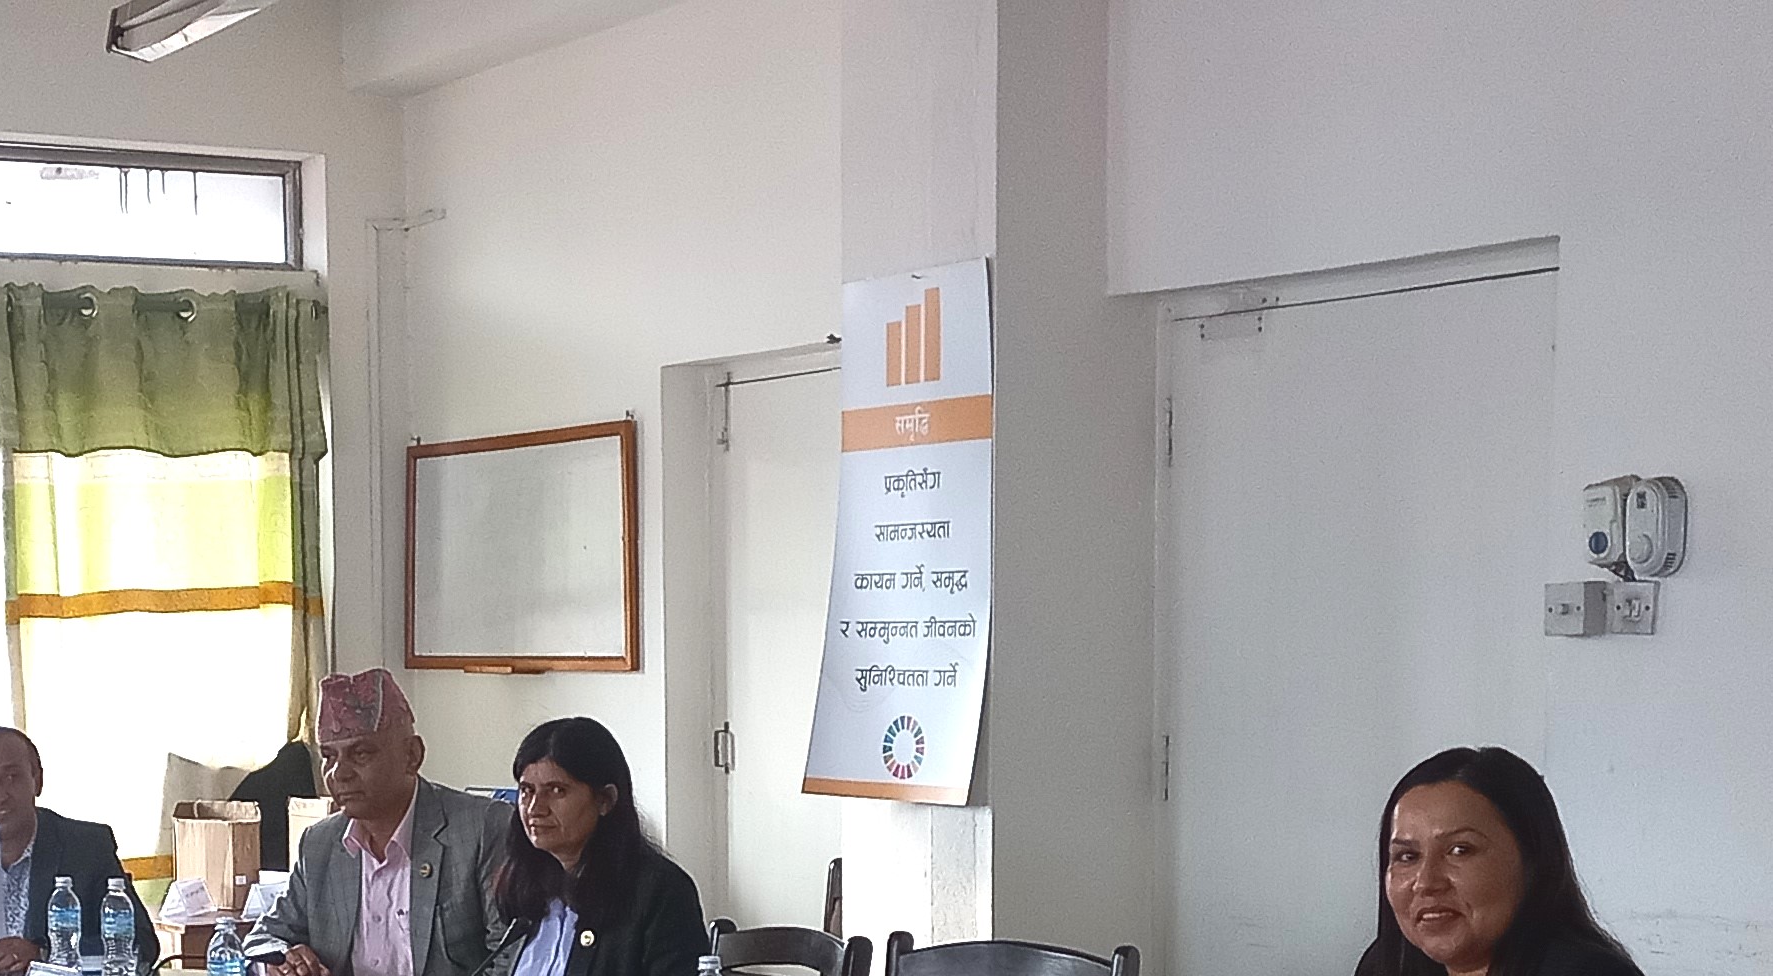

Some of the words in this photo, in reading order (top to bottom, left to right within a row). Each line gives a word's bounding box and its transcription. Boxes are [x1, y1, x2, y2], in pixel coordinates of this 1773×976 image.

[895, 407, 930, 441] समृद्धि
[854, 571, 896, 591] कायम
[931, 569, 969, 595] समृद्ध
[840, 621, 850, 639] र
[922, 612, 977, 638] जीवनको
[855, 664, 928, 692] सुनिश्चितता
[933, 662, 959, 687] गर्ने
